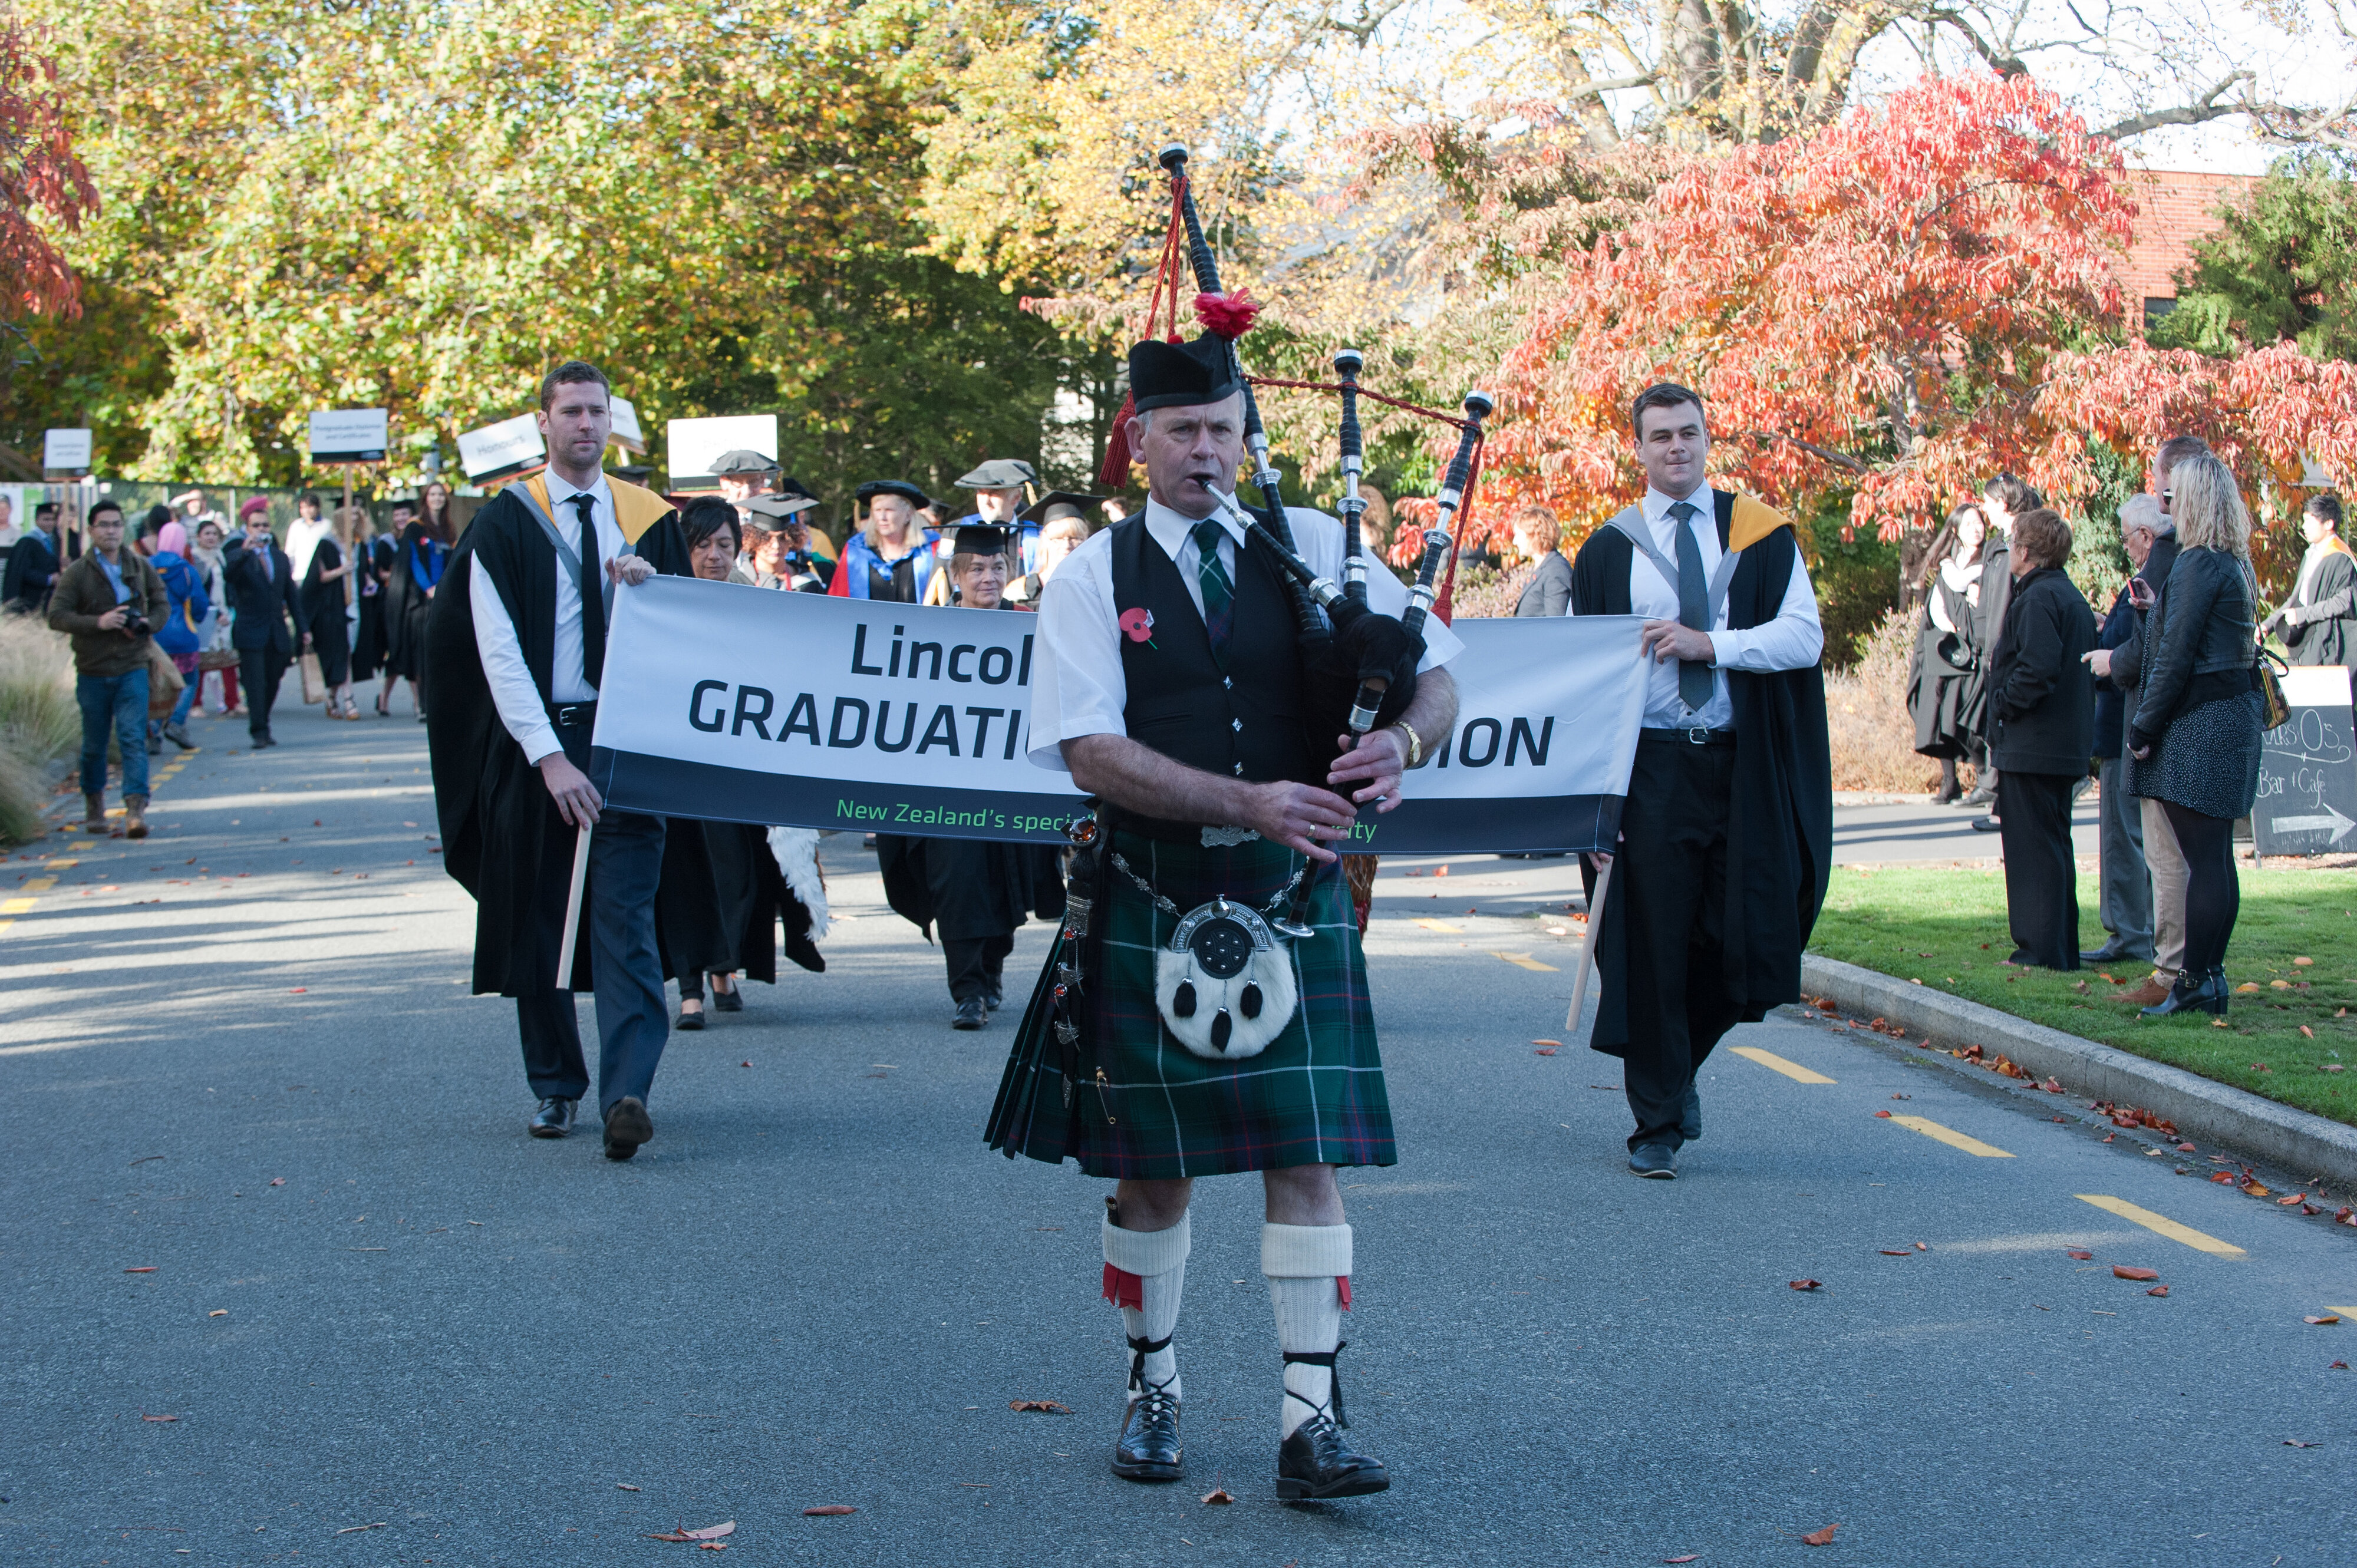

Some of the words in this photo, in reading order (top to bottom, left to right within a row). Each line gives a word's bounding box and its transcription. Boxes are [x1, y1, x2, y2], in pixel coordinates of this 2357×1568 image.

[851, 623, 1034, 686] Lincol
[689, 679, 1030, 761] GRADUATI
[1415, 716, 1554, 770] ION
[2256, 767, 2285, 798] Bar
[836, 799, 888, 821] New
[1013, 813, 1084, 833] speci
